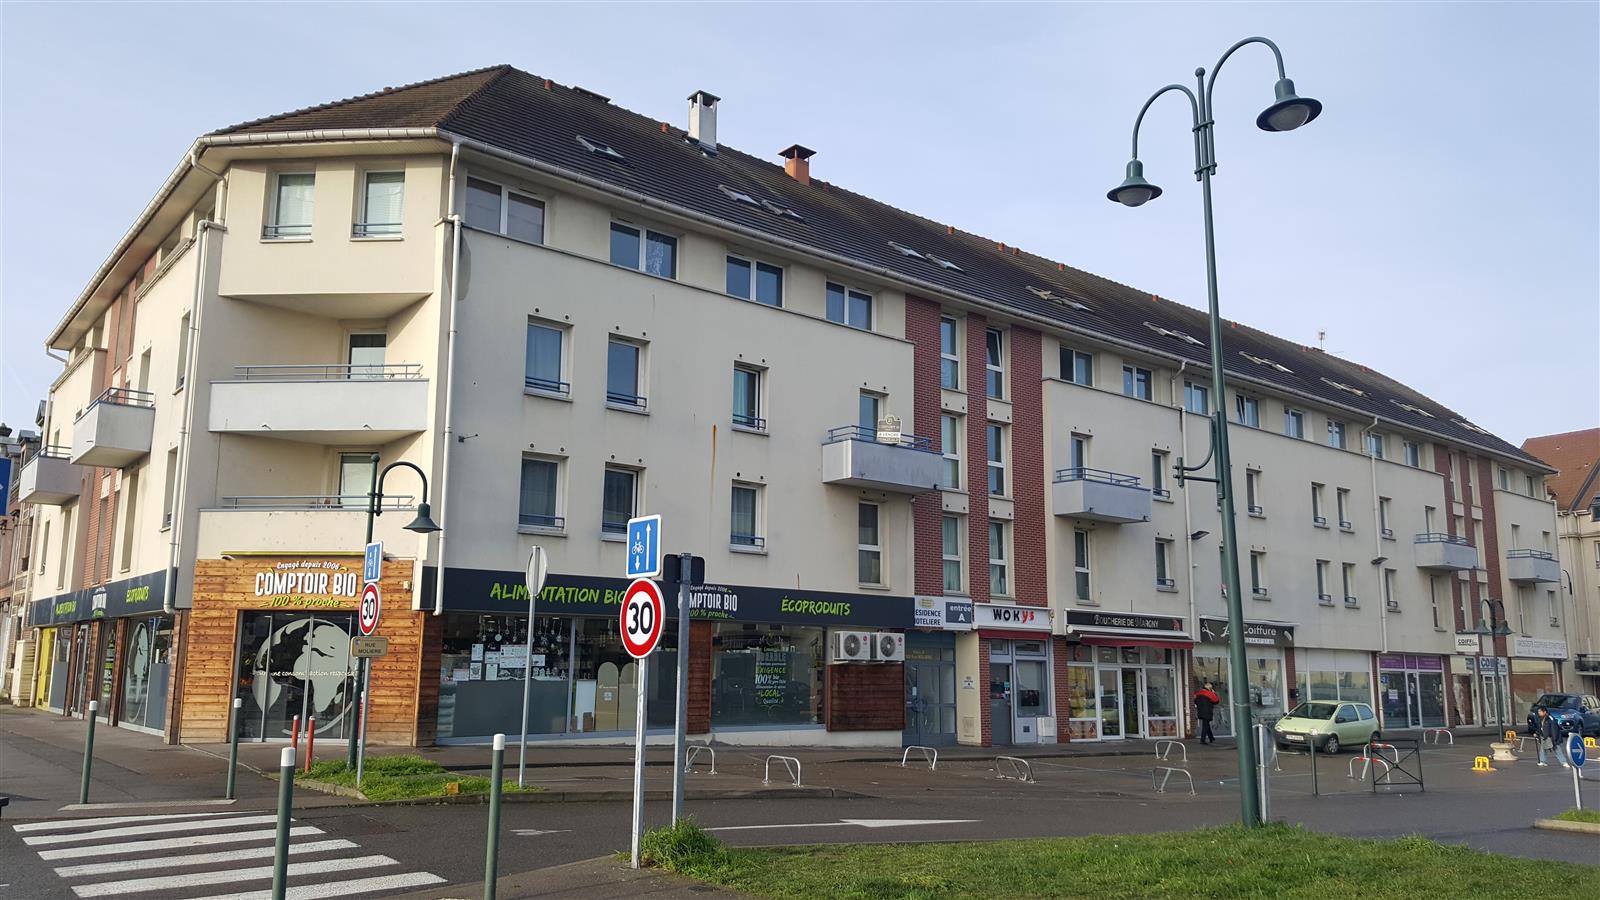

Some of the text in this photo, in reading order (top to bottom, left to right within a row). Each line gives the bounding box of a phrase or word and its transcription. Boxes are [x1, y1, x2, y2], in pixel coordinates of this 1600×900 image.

[300, 560, 321, 569] depuis
[322, 561, 340, 570] 2006
[255, 572, 357, 597] COMPTOIR BIO
[489, 582, 600, 604] ALIMNTATION
[271, 596, 340, 608] 100 % proche
[362, 598, 375, 620] 30
[677, 592, 738, 611] MPTOIR BIO
[781, 595, 851, 616] ÉCOPRODUITS
[628, 602, 653, 635] 30
[688, 609, 700, 617] 00
[707, 610, 729, 619] proche
[915, 608, 941, 617] ESIDENCE
[958, 613, 966, 622] A
[915, 617, 941, 626] OTELIERE
